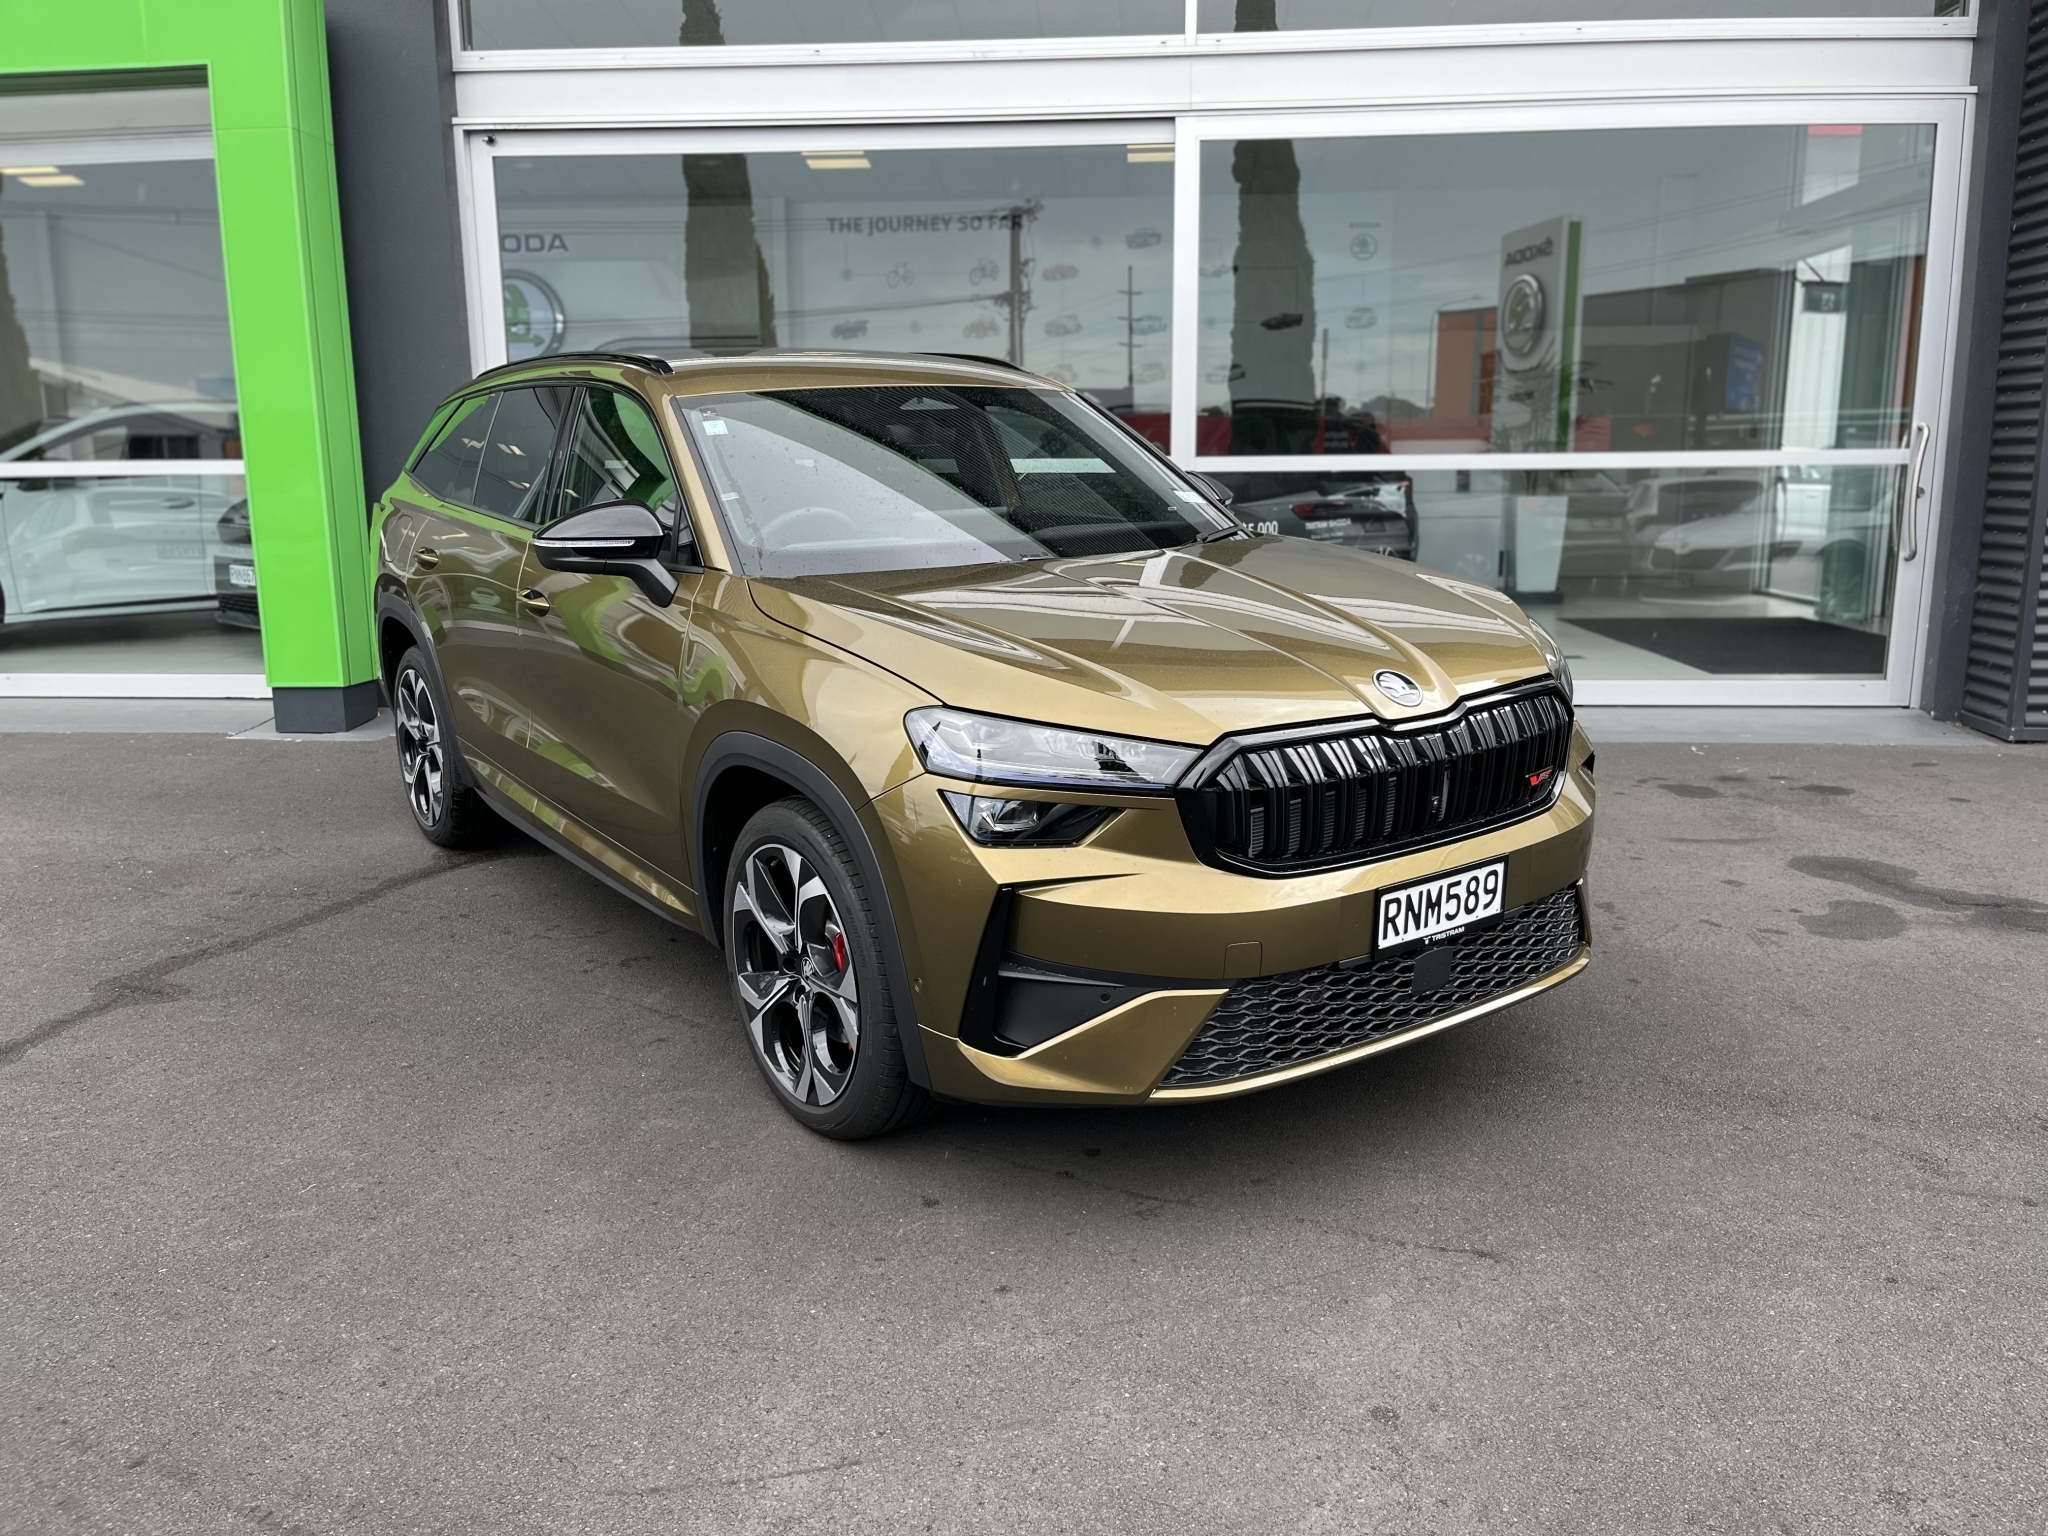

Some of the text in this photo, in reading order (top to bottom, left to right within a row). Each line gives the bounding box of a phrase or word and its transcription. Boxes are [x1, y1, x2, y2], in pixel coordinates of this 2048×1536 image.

[826, 217, 864, 234] THE
[867, 214, 952, 237] JOURNEY
[957, 214, 983, 232] SO
[1305, 520, 1328, 530] TRISTRAM
[1382, 869, 1499, 940] RNM589
[1432, 926, 1465, 942] TRISTRAM
